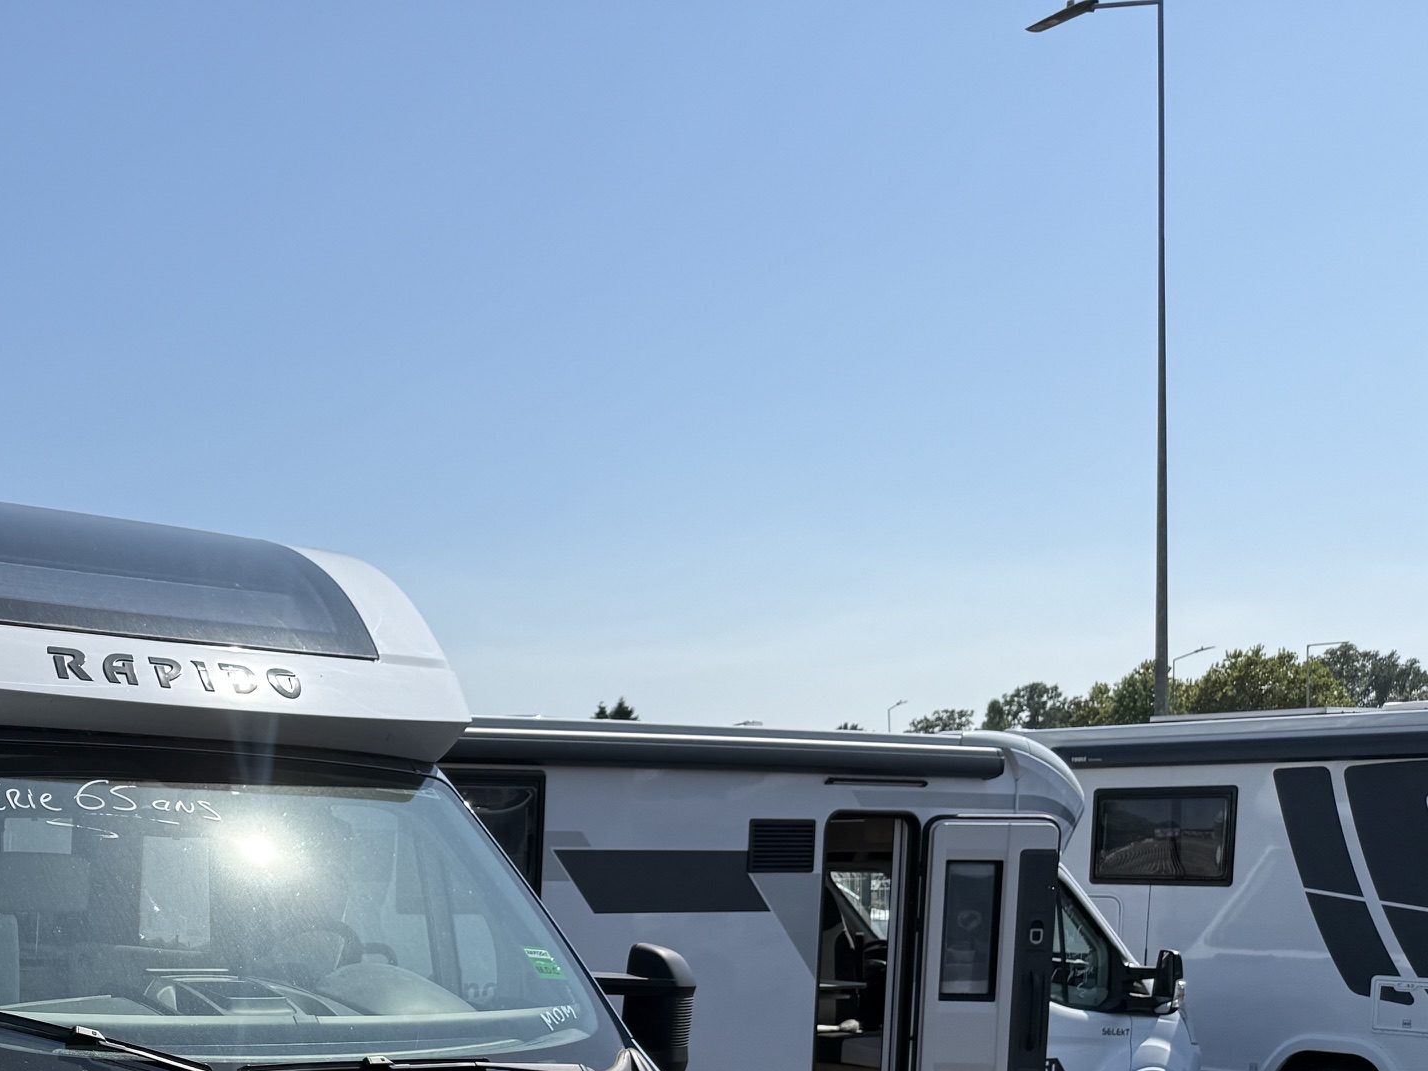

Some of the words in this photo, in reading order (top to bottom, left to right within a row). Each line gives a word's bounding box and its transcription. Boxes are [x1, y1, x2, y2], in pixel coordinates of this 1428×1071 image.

[46, 645, 302, 700] RAPIDO
[74, 779, 137, 811] 65
[151, 799, 222, 821] ans
